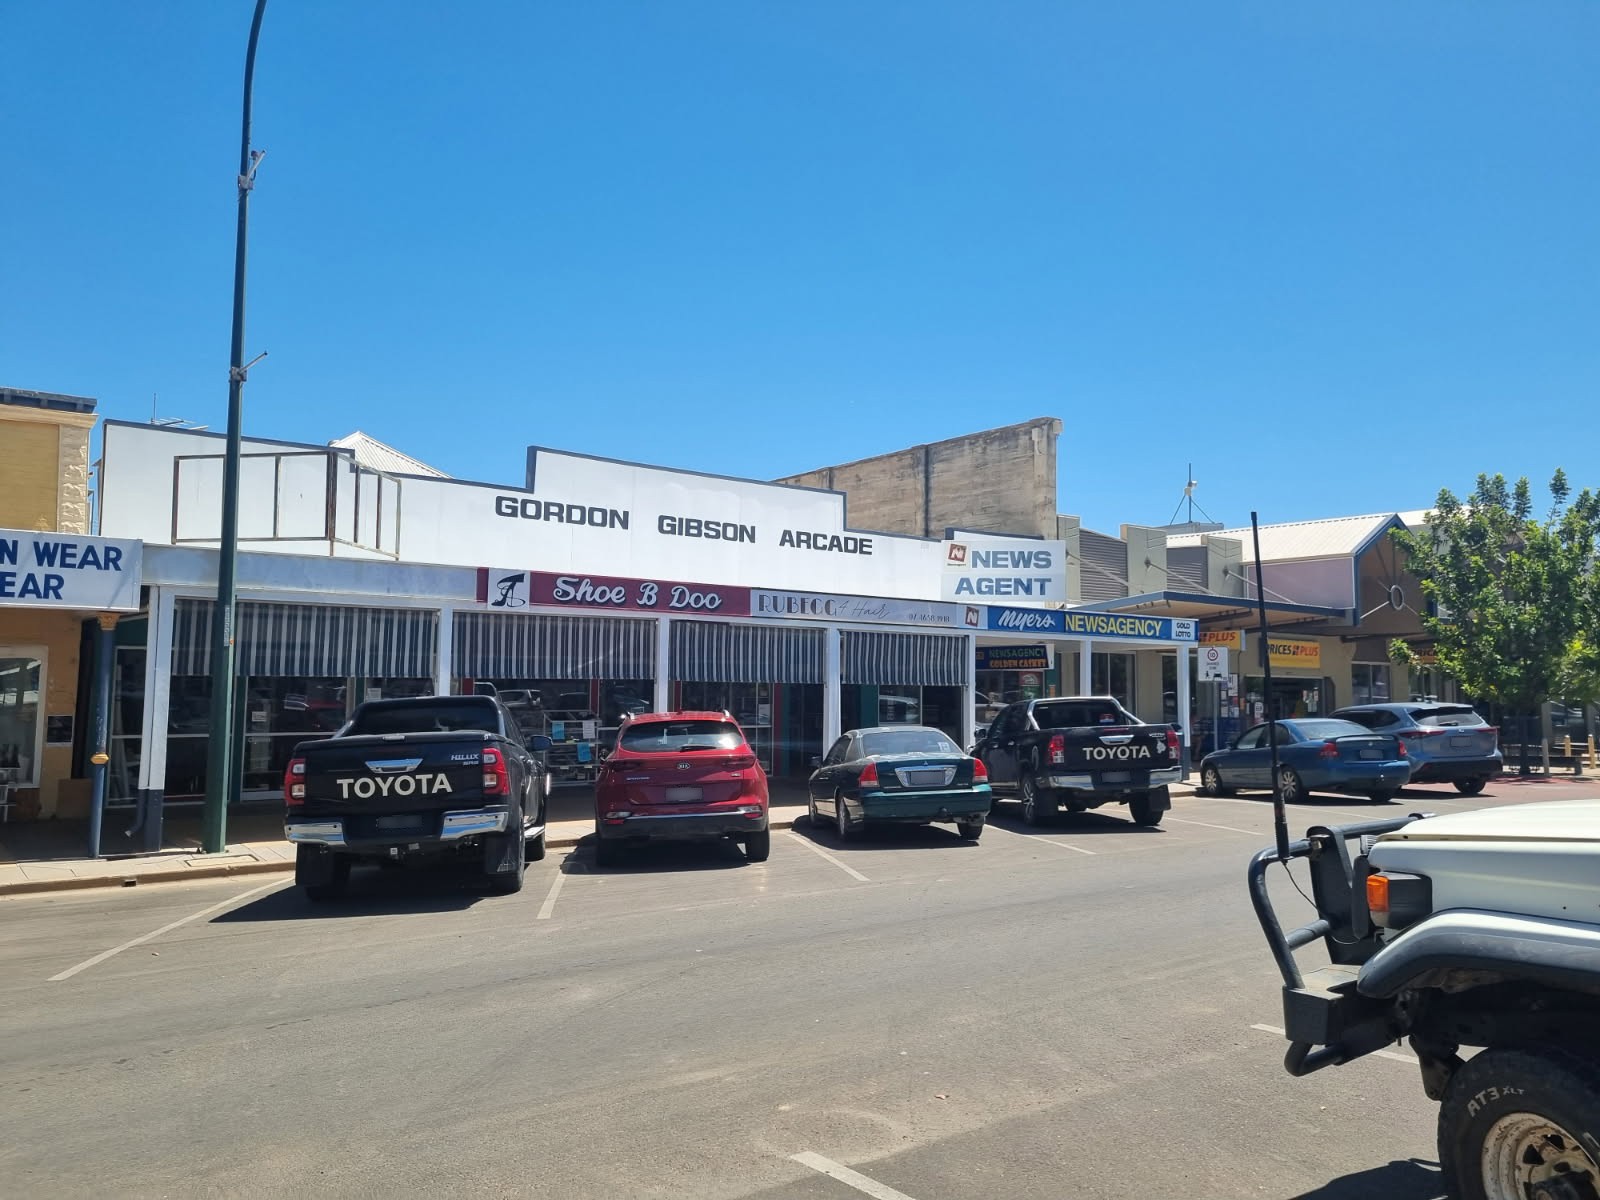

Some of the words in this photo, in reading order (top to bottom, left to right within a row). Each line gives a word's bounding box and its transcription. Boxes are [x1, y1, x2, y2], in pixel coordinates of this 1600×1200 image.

[495, 496, 630, 530] GORDON
[657, 514, 756, 544] GIBSON
[779, 529, 873, 555] ARCADE
[33, 541, 122, 571] WEAR
[971, 550, 1052, 569] NEWS
[553, 576, 626, 604] Shoe
[636, 582, 658, 606] B
[671, 586, 722, 610] Doo
[954, 577, 1052, 597] AGENT
[998, 609, 1056, 631] Myers
[1065, 614, 1162, 637] NEWSAGENCY
[1175, 630, 1191, 638] LOTTO
[1208, 632, 1236, 642] PLUS
[989, 648, 1045, 658] NEWSAGENCY
[1300, 645, 1319, 656] PLUS
[1082, 745, 1151, 760] TOYOTA
[337, 773, 452, 799] TOYOTA
[1467, 1087, 1500, 1118] AT3
[1502, 1086, 1525, 1096] XLT
